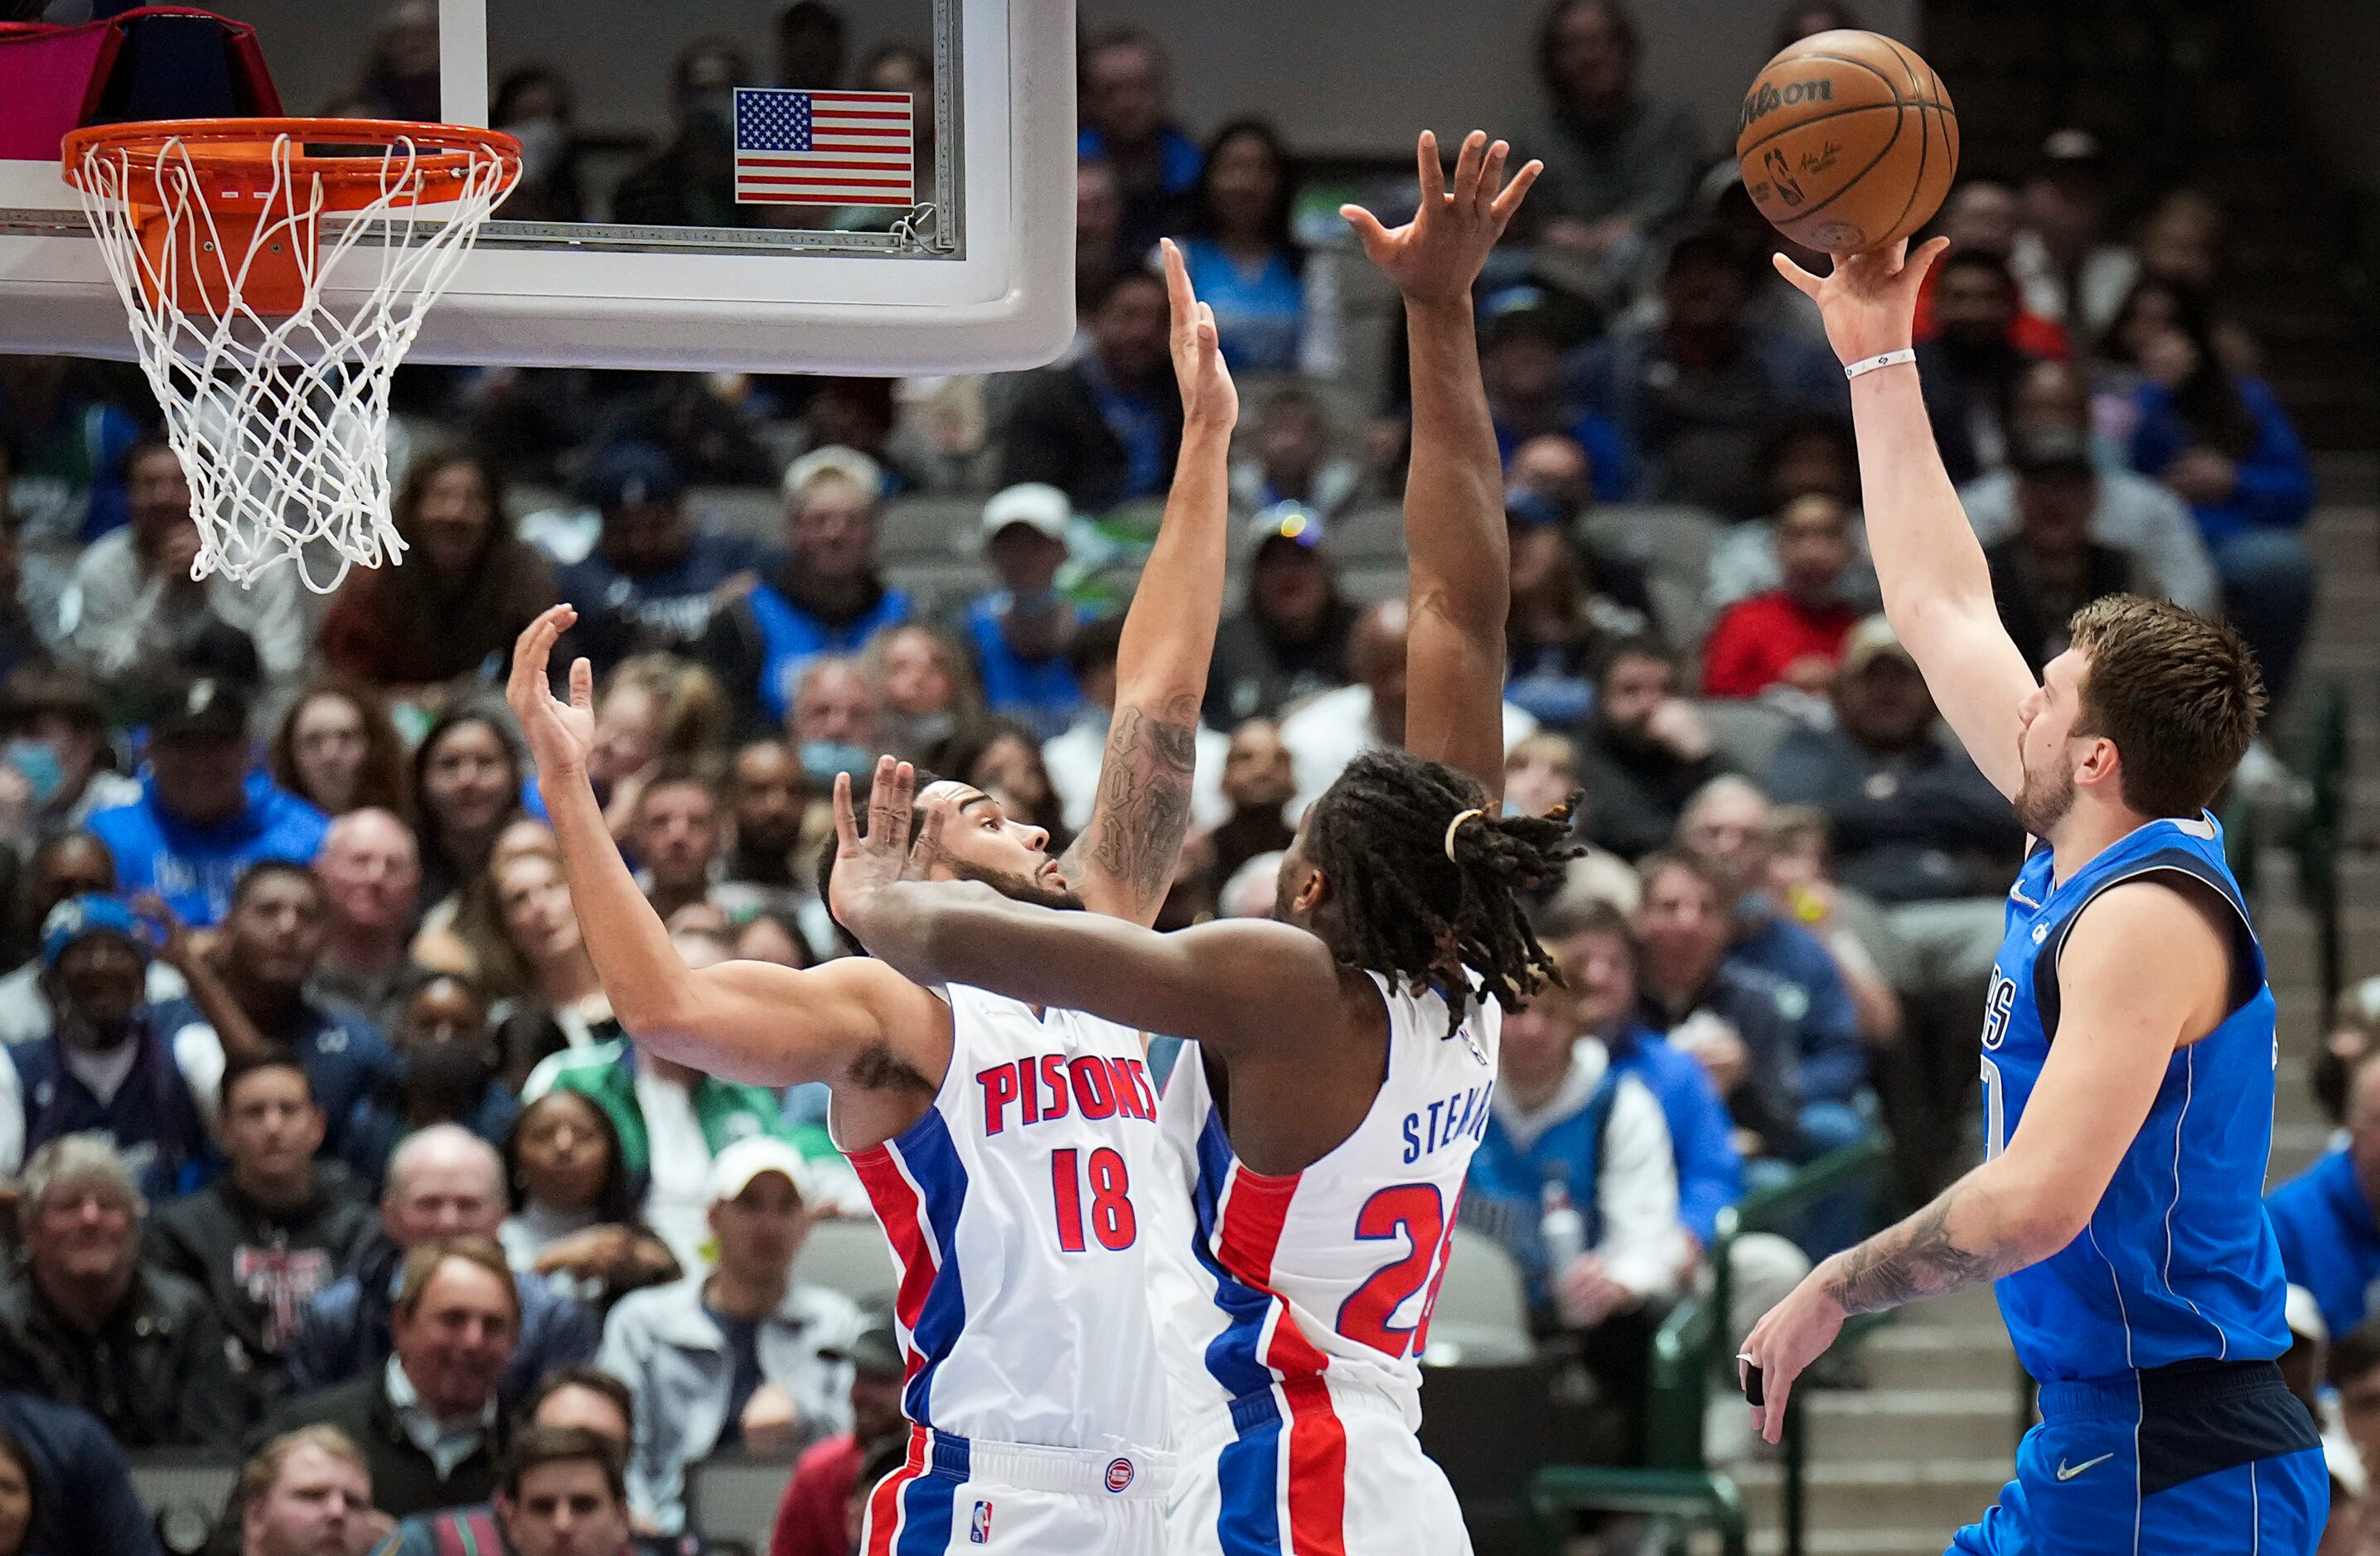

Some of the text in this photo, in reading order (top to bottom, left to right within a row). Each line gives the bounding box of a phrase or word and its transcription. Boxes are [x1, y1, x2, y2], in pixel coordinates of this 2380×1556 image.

[1739, 79, 1834, 133] ilson
[976, 1053, 1157, 1138] PISONS
[1051, 1147, 1137, 1253] 18
